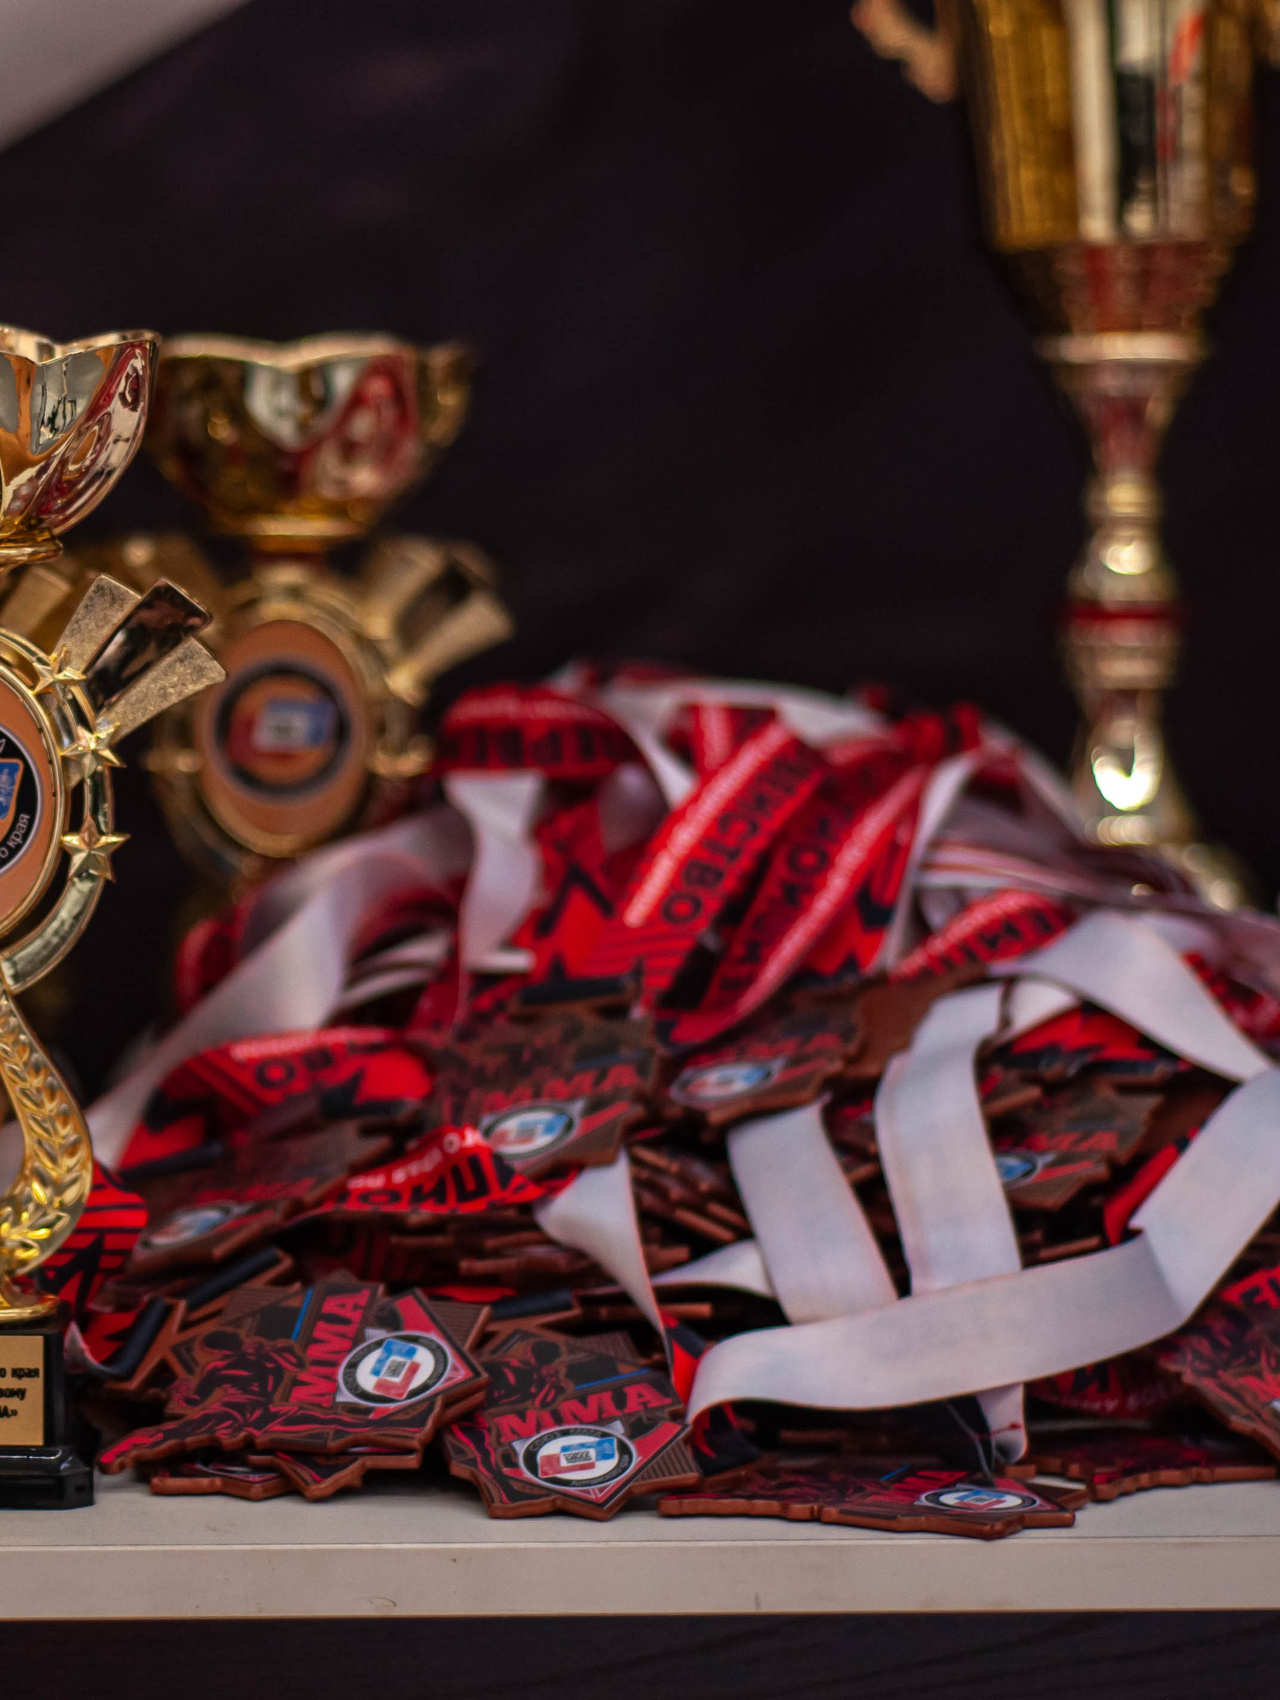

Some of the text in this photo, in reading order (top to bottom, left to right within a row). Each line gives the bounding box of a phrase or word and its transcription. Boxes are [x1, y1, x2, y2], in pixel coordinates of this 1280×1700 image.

[7, 813, 31, 848] края
[11, 1367, 40, 1380] края
[492, 1383, 673, 1442] ММА
